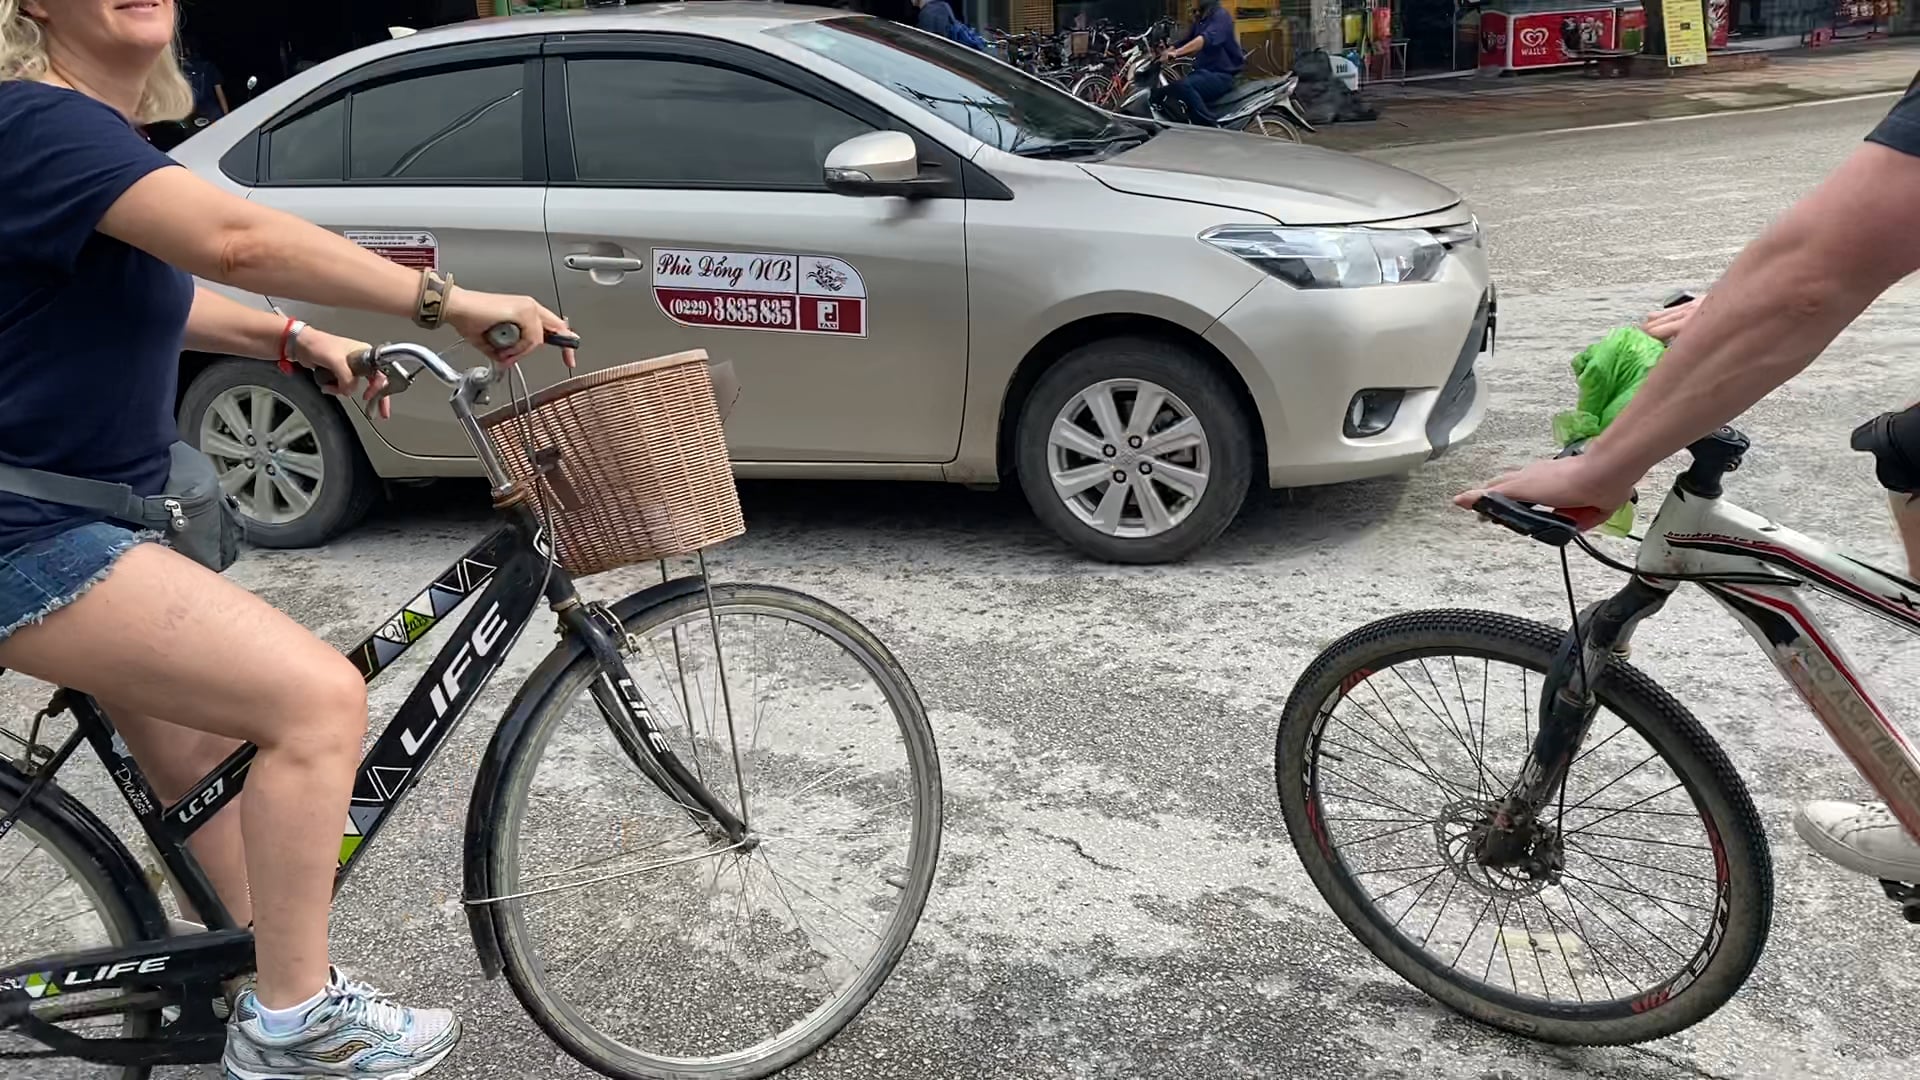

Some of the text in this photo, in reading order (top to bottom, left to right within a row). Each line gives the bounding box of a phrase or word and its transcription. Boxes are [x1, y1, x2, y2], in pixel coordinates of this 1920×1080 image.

[656, 253, 692, 276] Phù
[697, 255, 743, 287] Đổng
[669, 298, 712, 319] (0229)
[400, 601, 509, 757] LIFE
[617, 678, 672, 754] LIFE
[63, 956, 170, 986] LIFE
